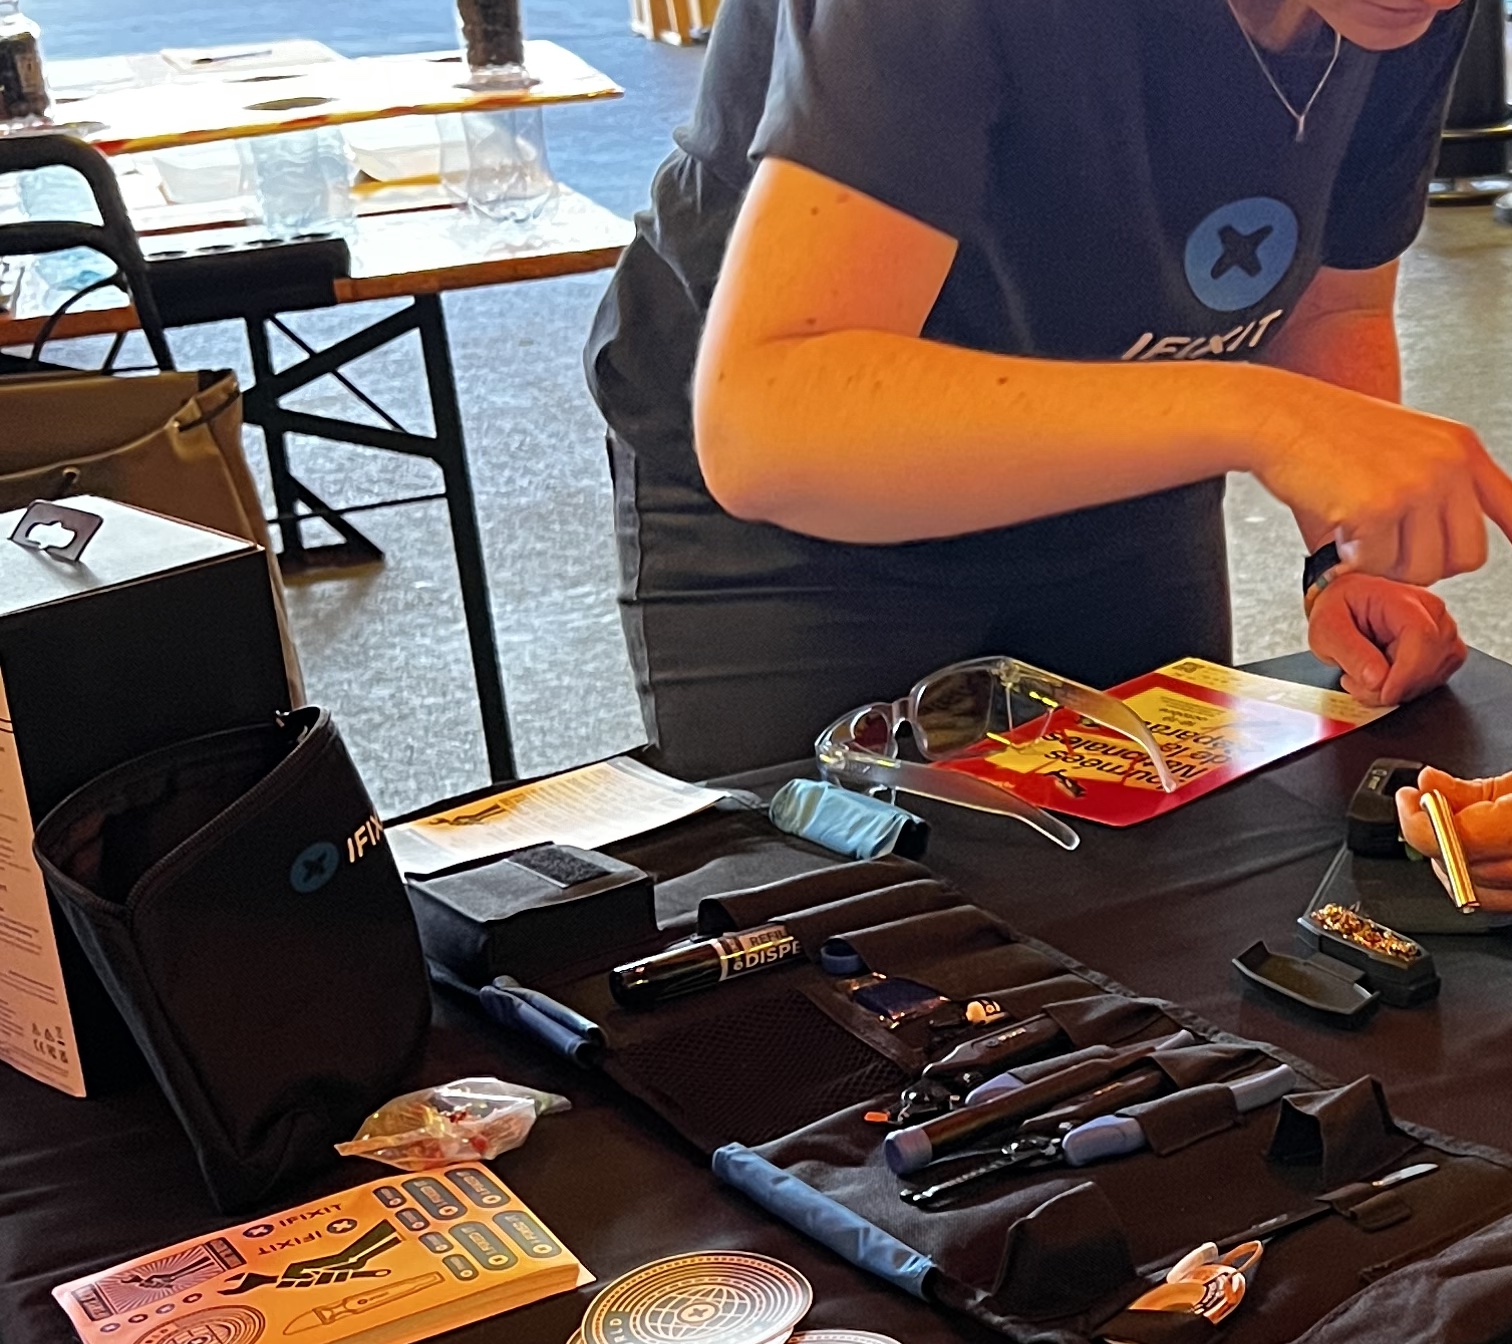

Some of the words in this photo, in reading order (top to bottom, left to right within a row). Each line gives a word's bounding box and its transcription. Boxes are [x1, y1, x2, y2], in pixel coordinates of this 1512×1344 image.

[347, 814, 385, 864] IFIX
[742, 938, 803, 970] DISPE
[279, 1203, 340, 1226] IFIXIT
[259, 1231, 321, 1254] IFIXIT
